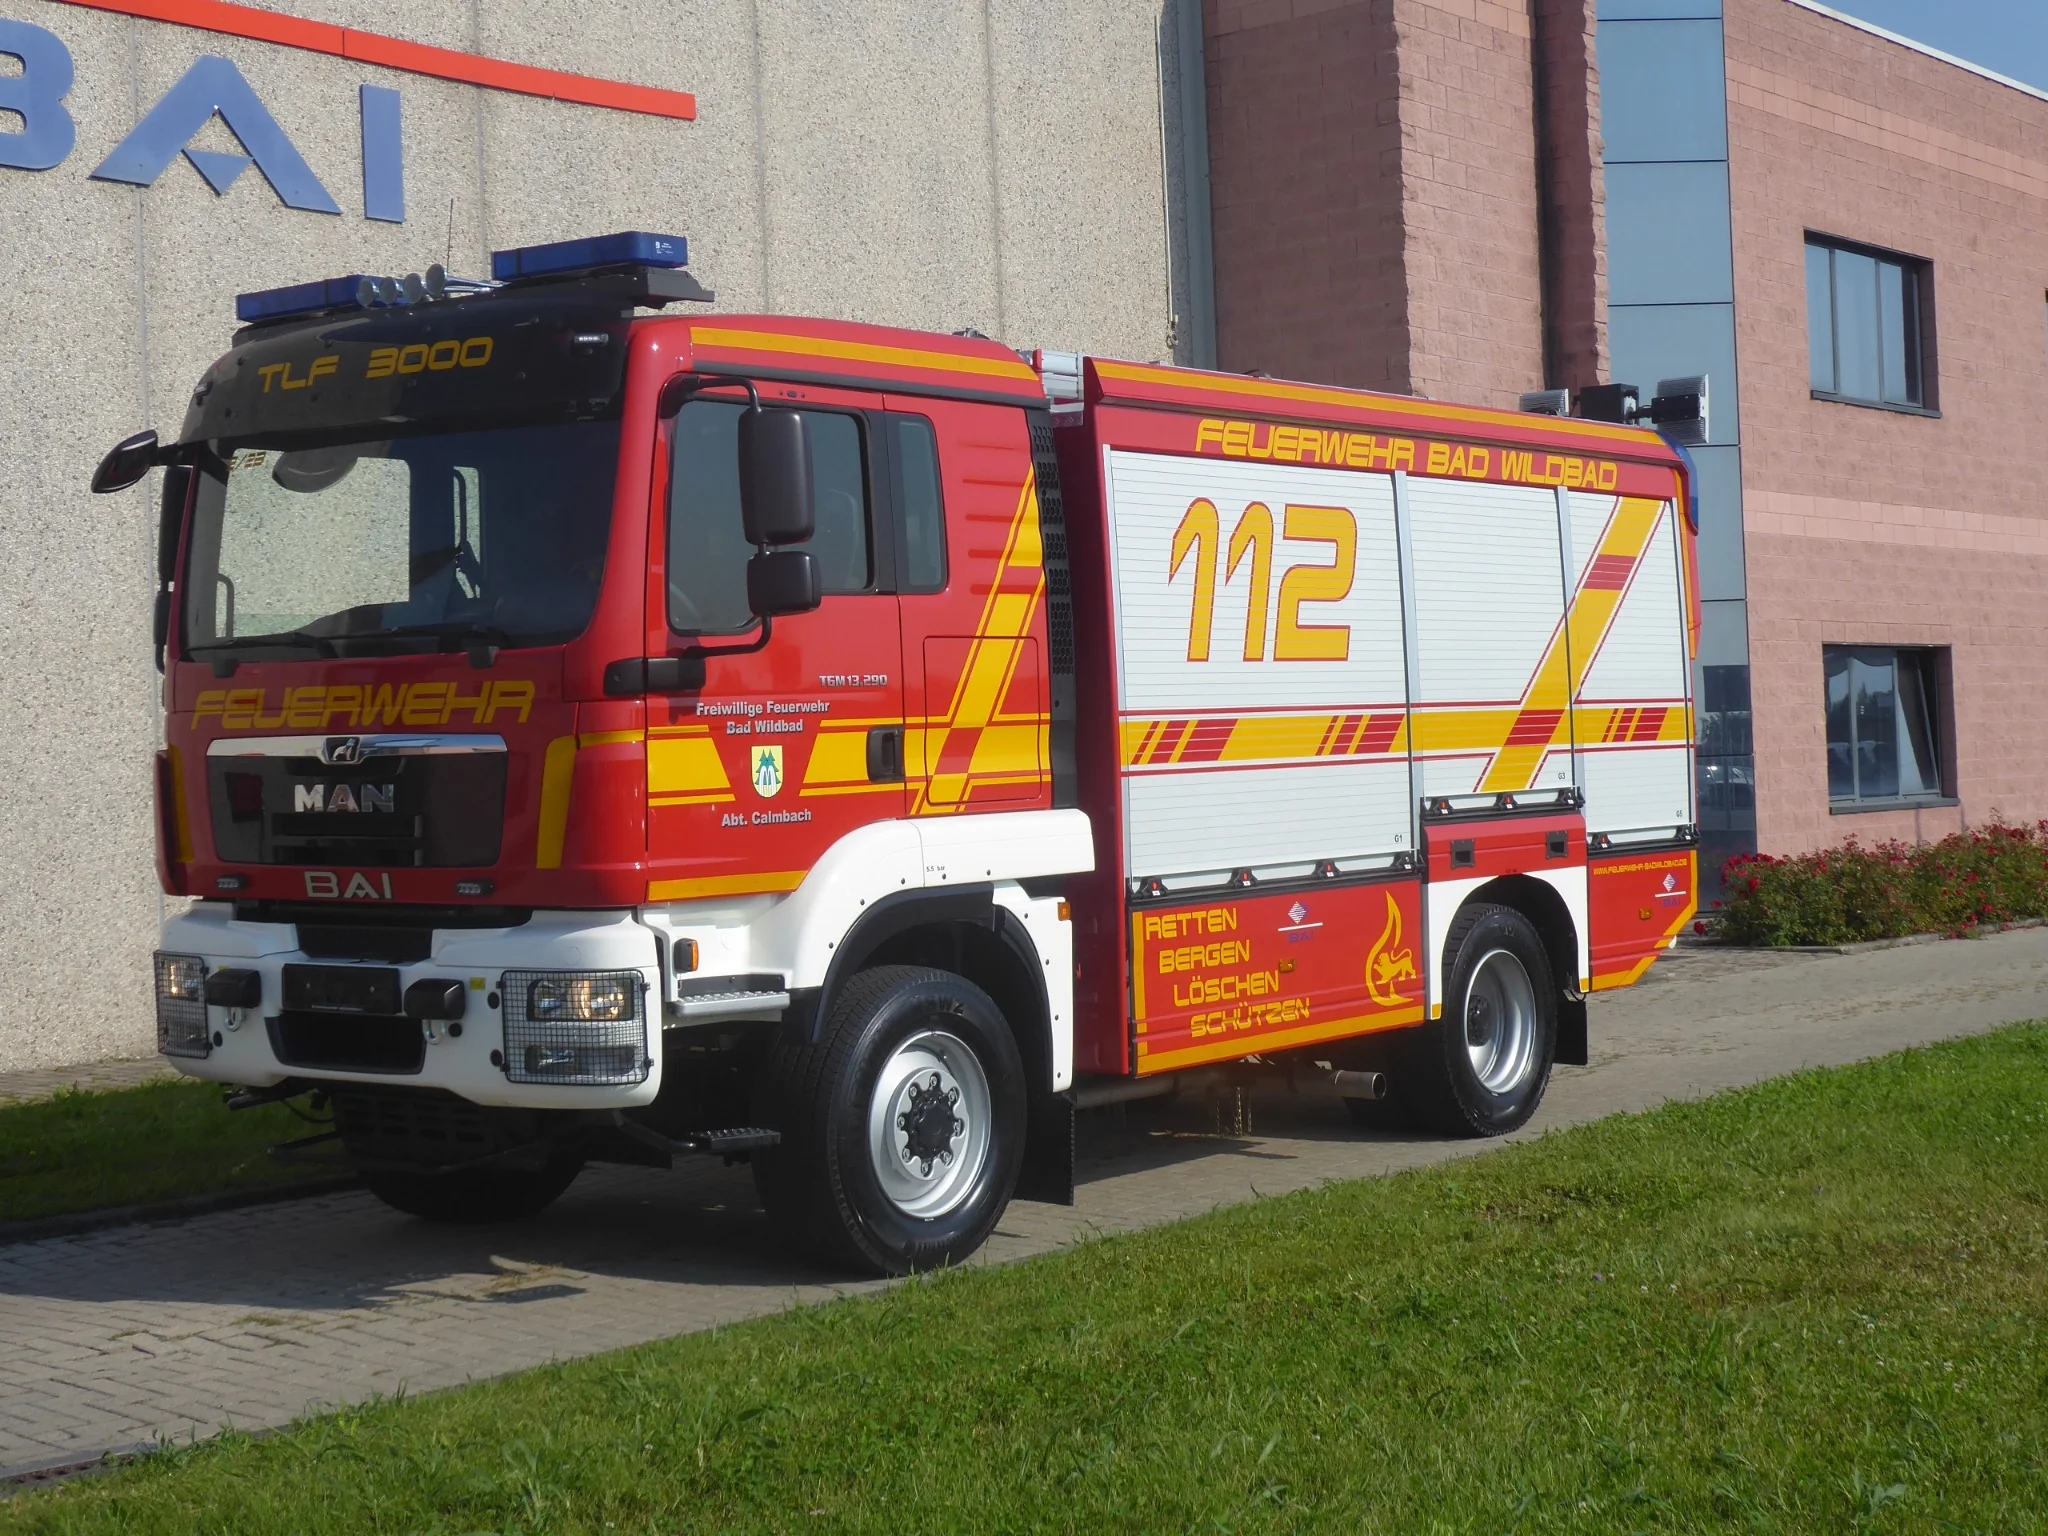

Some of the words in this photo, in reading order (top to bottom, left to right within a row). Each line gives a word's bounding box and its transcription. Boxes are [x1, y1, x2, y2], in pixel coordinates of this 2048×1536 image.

[0, 18, 405, 223] BAI
[257, 355, 341, 394] TLF
[365, 336, 495, 379] 3000
[1195, 419, 1415, 471] FEUERWEHR
[1427, 444, 1490, 479] BAD
[1501, 450, 1618, 491] WILDBAD
[1168, 497, 1357, 662] 112
[819, 674, 846, 688] TGM
[847, 674, 888, 687] 13.290
[191, 680, 536, 730] FEUERWEHR
[696, 703, 763, 718] Freiwillige
[766, 700, 830, 715] Feuerwehr
[726, 721, 752, 735] Bad
[755, 719, 804, 733] Wildbad
[294, 784, 394, 813] MAN
[721, 813, 748, 828] Abt.
[751, 808, 812, 825] Calmbach
[1394, 833, 1403, 844] G1
[304, 870, 392, 900] BAI
[1145, 907, 1237, 941] RETTEN
[1159, 939, 1250, 974] BERGEN
[1173, 969, 1279, 1008] LÖSCHEN
[1190, 997, 1310, 1038] SCHÜTZEN
